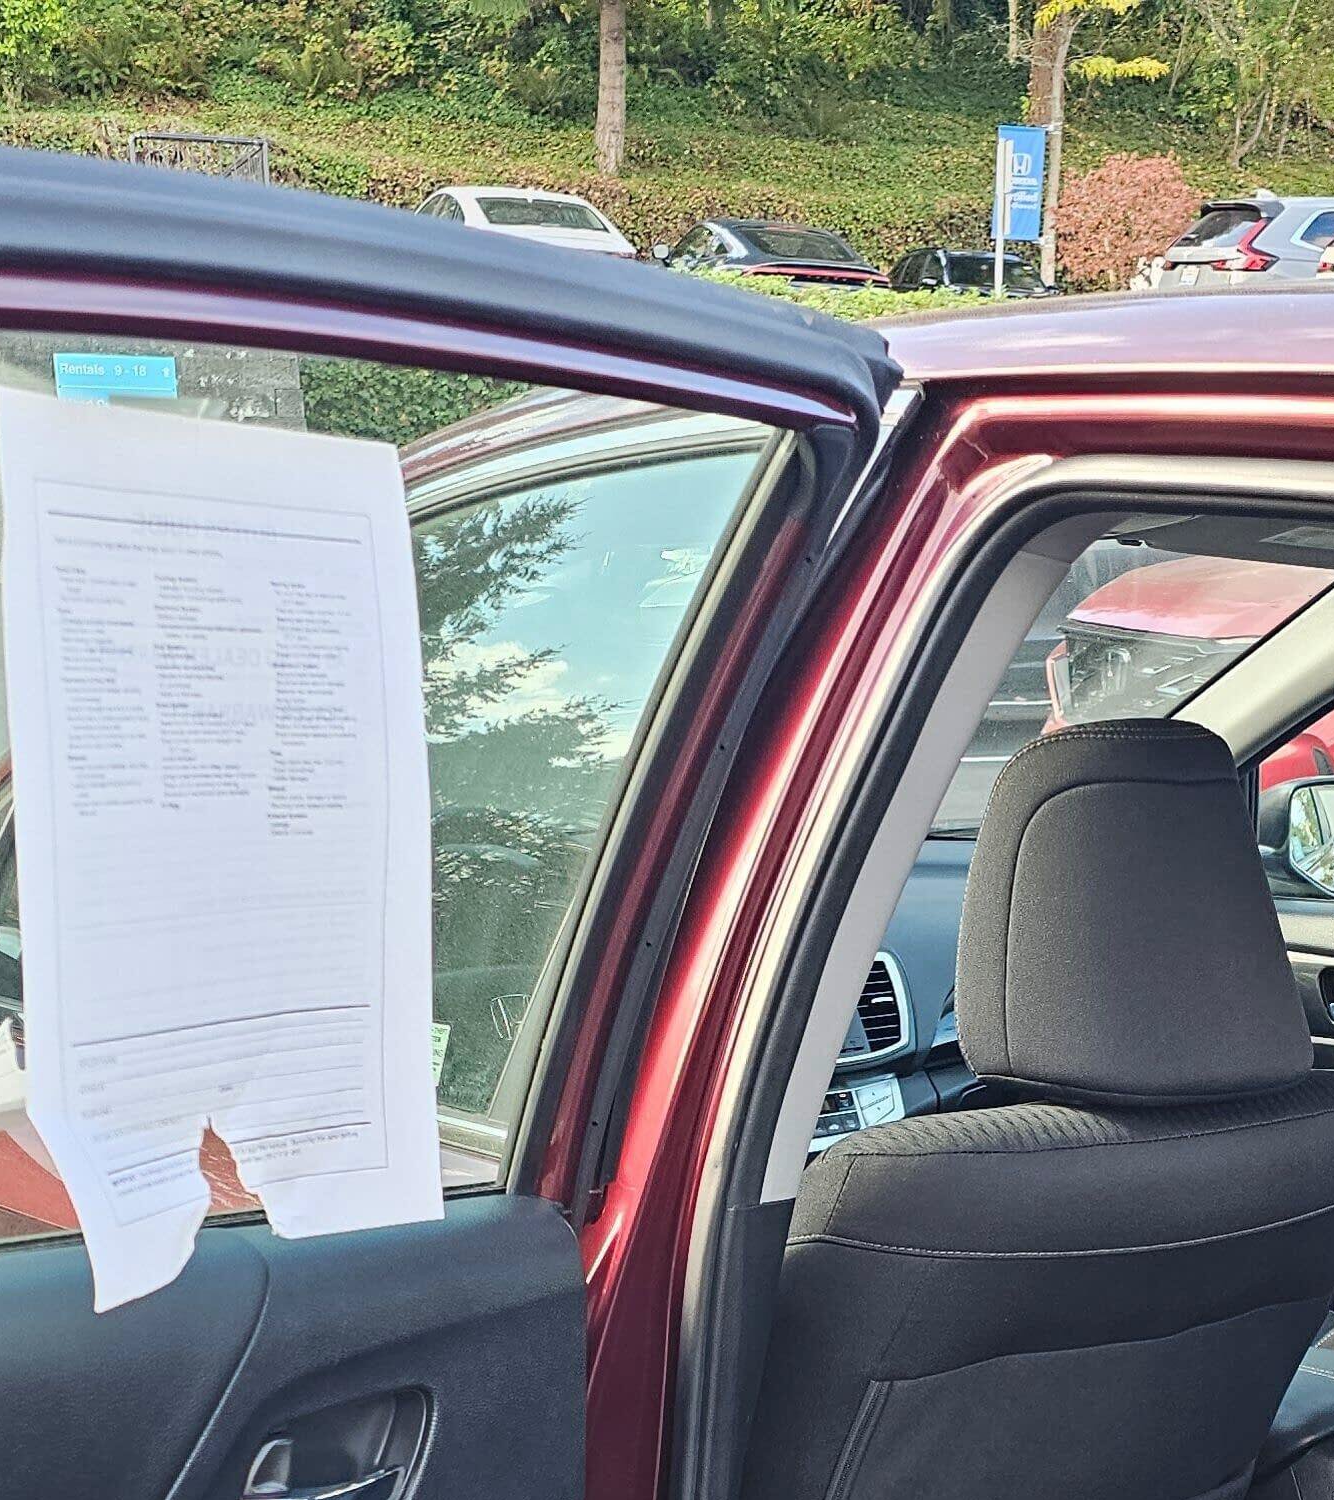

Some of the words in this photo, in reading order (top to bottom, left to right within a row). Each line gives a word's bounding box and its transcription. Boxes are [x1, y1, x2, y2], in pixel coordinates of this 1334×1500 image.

[59, 362, 105, 376] Rentals
[113, 364, 123, 377] 9
[131, 364, 147, 377] 18
